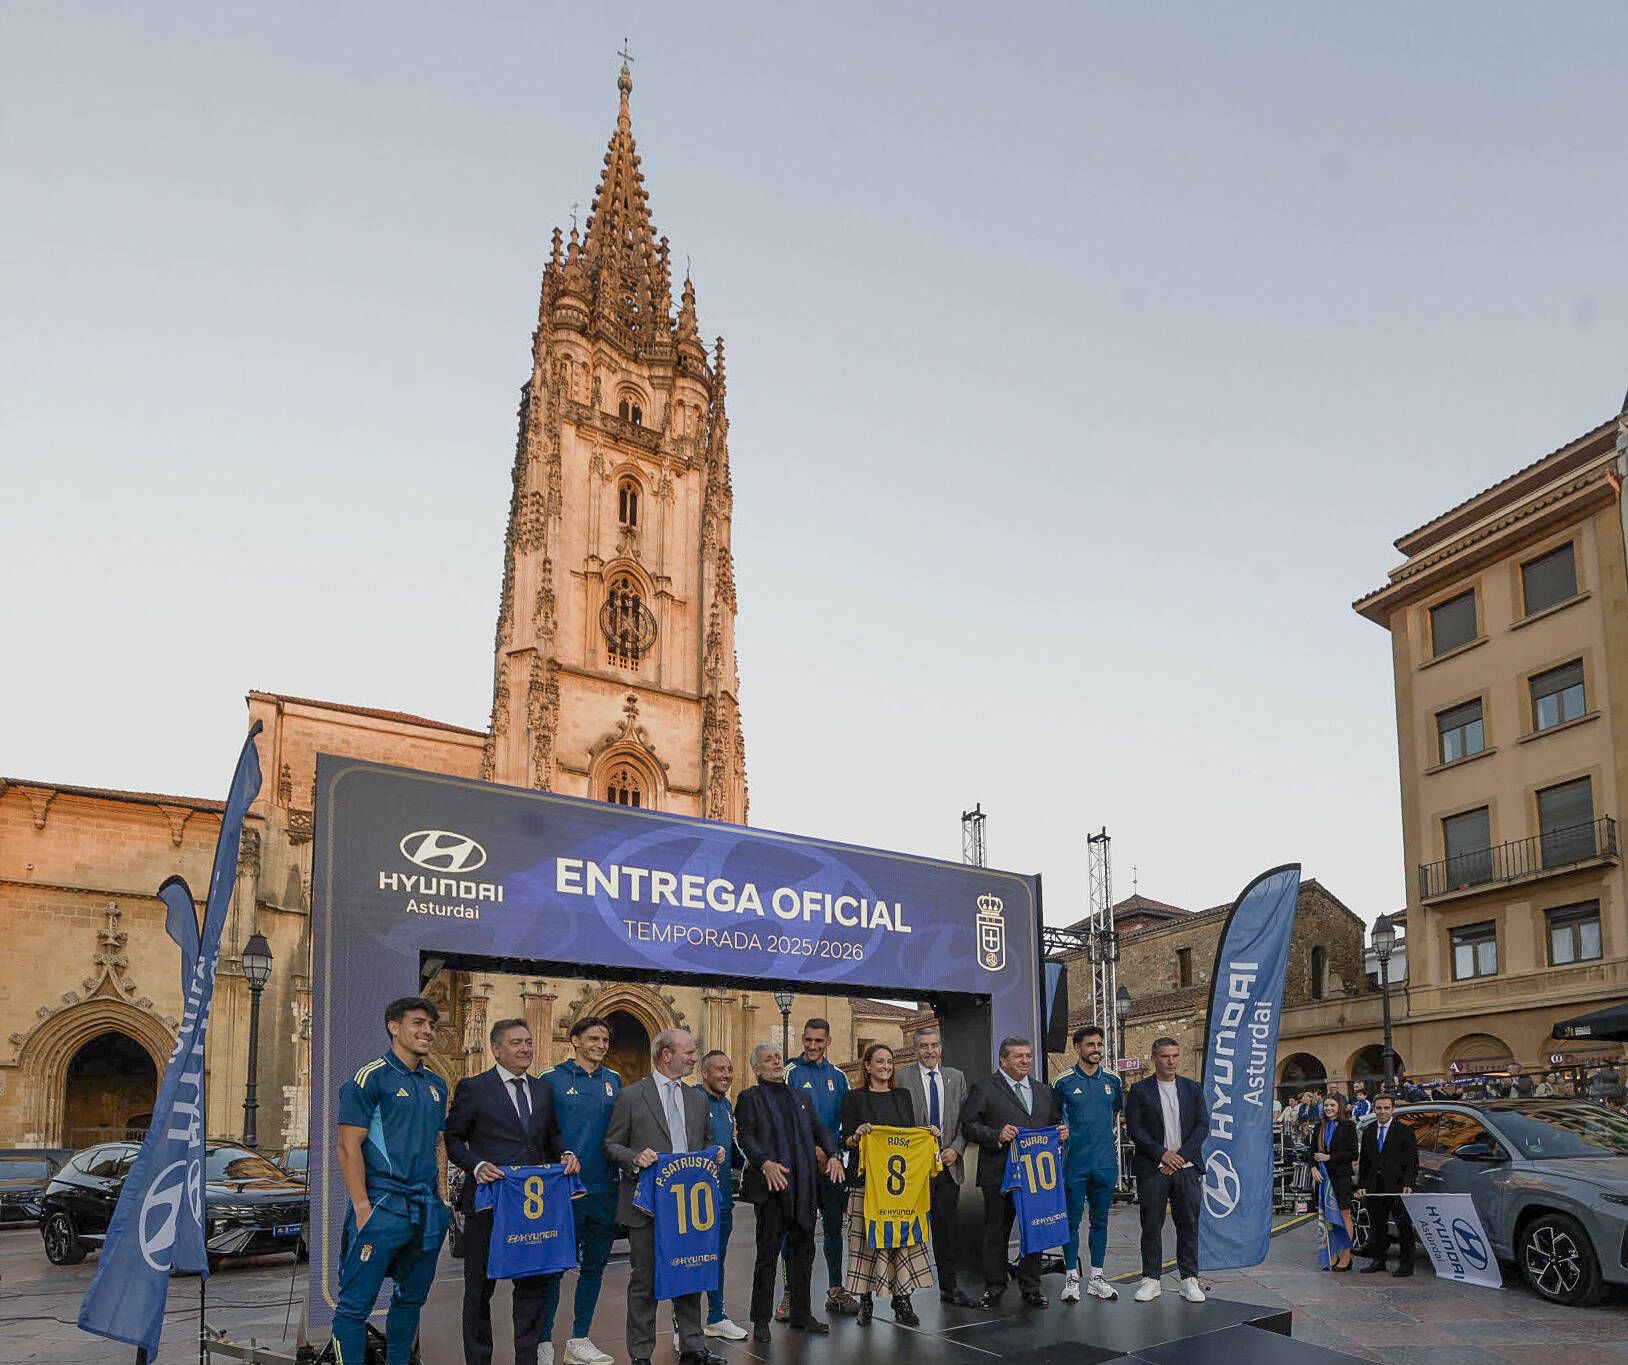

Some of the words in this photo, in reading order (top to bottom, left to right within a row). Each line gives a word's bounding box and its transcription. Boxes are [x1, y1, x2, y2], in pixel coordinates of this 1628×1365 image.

[379, 871, 504, 903] HYUNDAI
[556, 857, 765, 917] ENTREGA
[772, 887, 912, 933] OFICIAL
[406, 898, 480, 920] Asturdai
[623, 919, 762, 951] TEMPORADA
[767, 935, 864, 961] 2025/2026
[1210, 962, 1259, 1141] HYUNDAI
[1243, 1001, 1273, 1107] Asturdai
[887, 1136, 910, 1149] ROSA
[1020, 1135, 1048, 1149] CURRO
[886, 1154, 906, 1196] 8
[1020, 1151, 1057, 1194] 10
[523, 1175, 544, 1220] 8
[669, 1181, 715, 1235] 10
[1419, 1220, 1446, 1263] Asturdai
[1425, 1206, 1465, 1280] HYUNDAI
